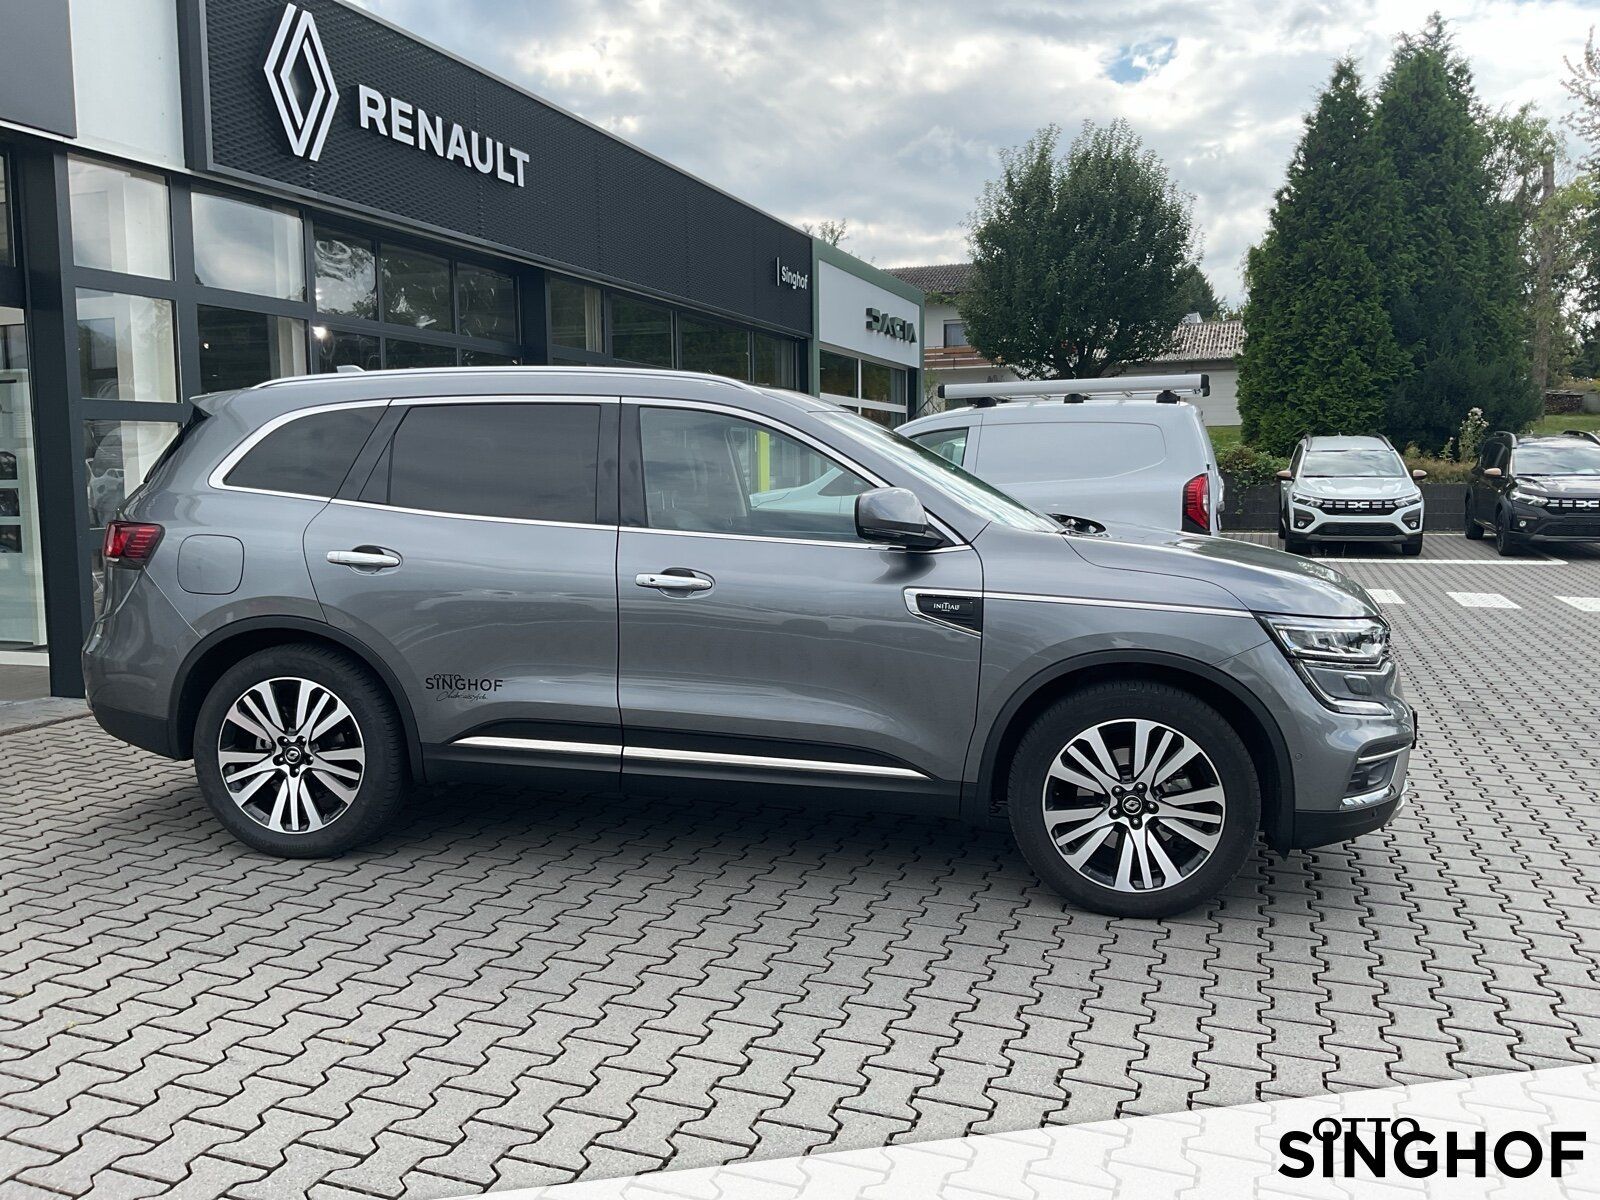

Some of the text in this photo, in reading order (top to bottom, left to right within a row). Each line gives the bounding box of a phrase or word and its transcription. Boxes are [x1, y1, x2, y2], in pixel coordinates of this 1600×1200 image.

[359, 84, 530, 187] RENAULT
[781, 265, 808, 290] Singhof
[866, 307, 917, 343] DACIA
[425, 677, 504, 692] SINGHOF
